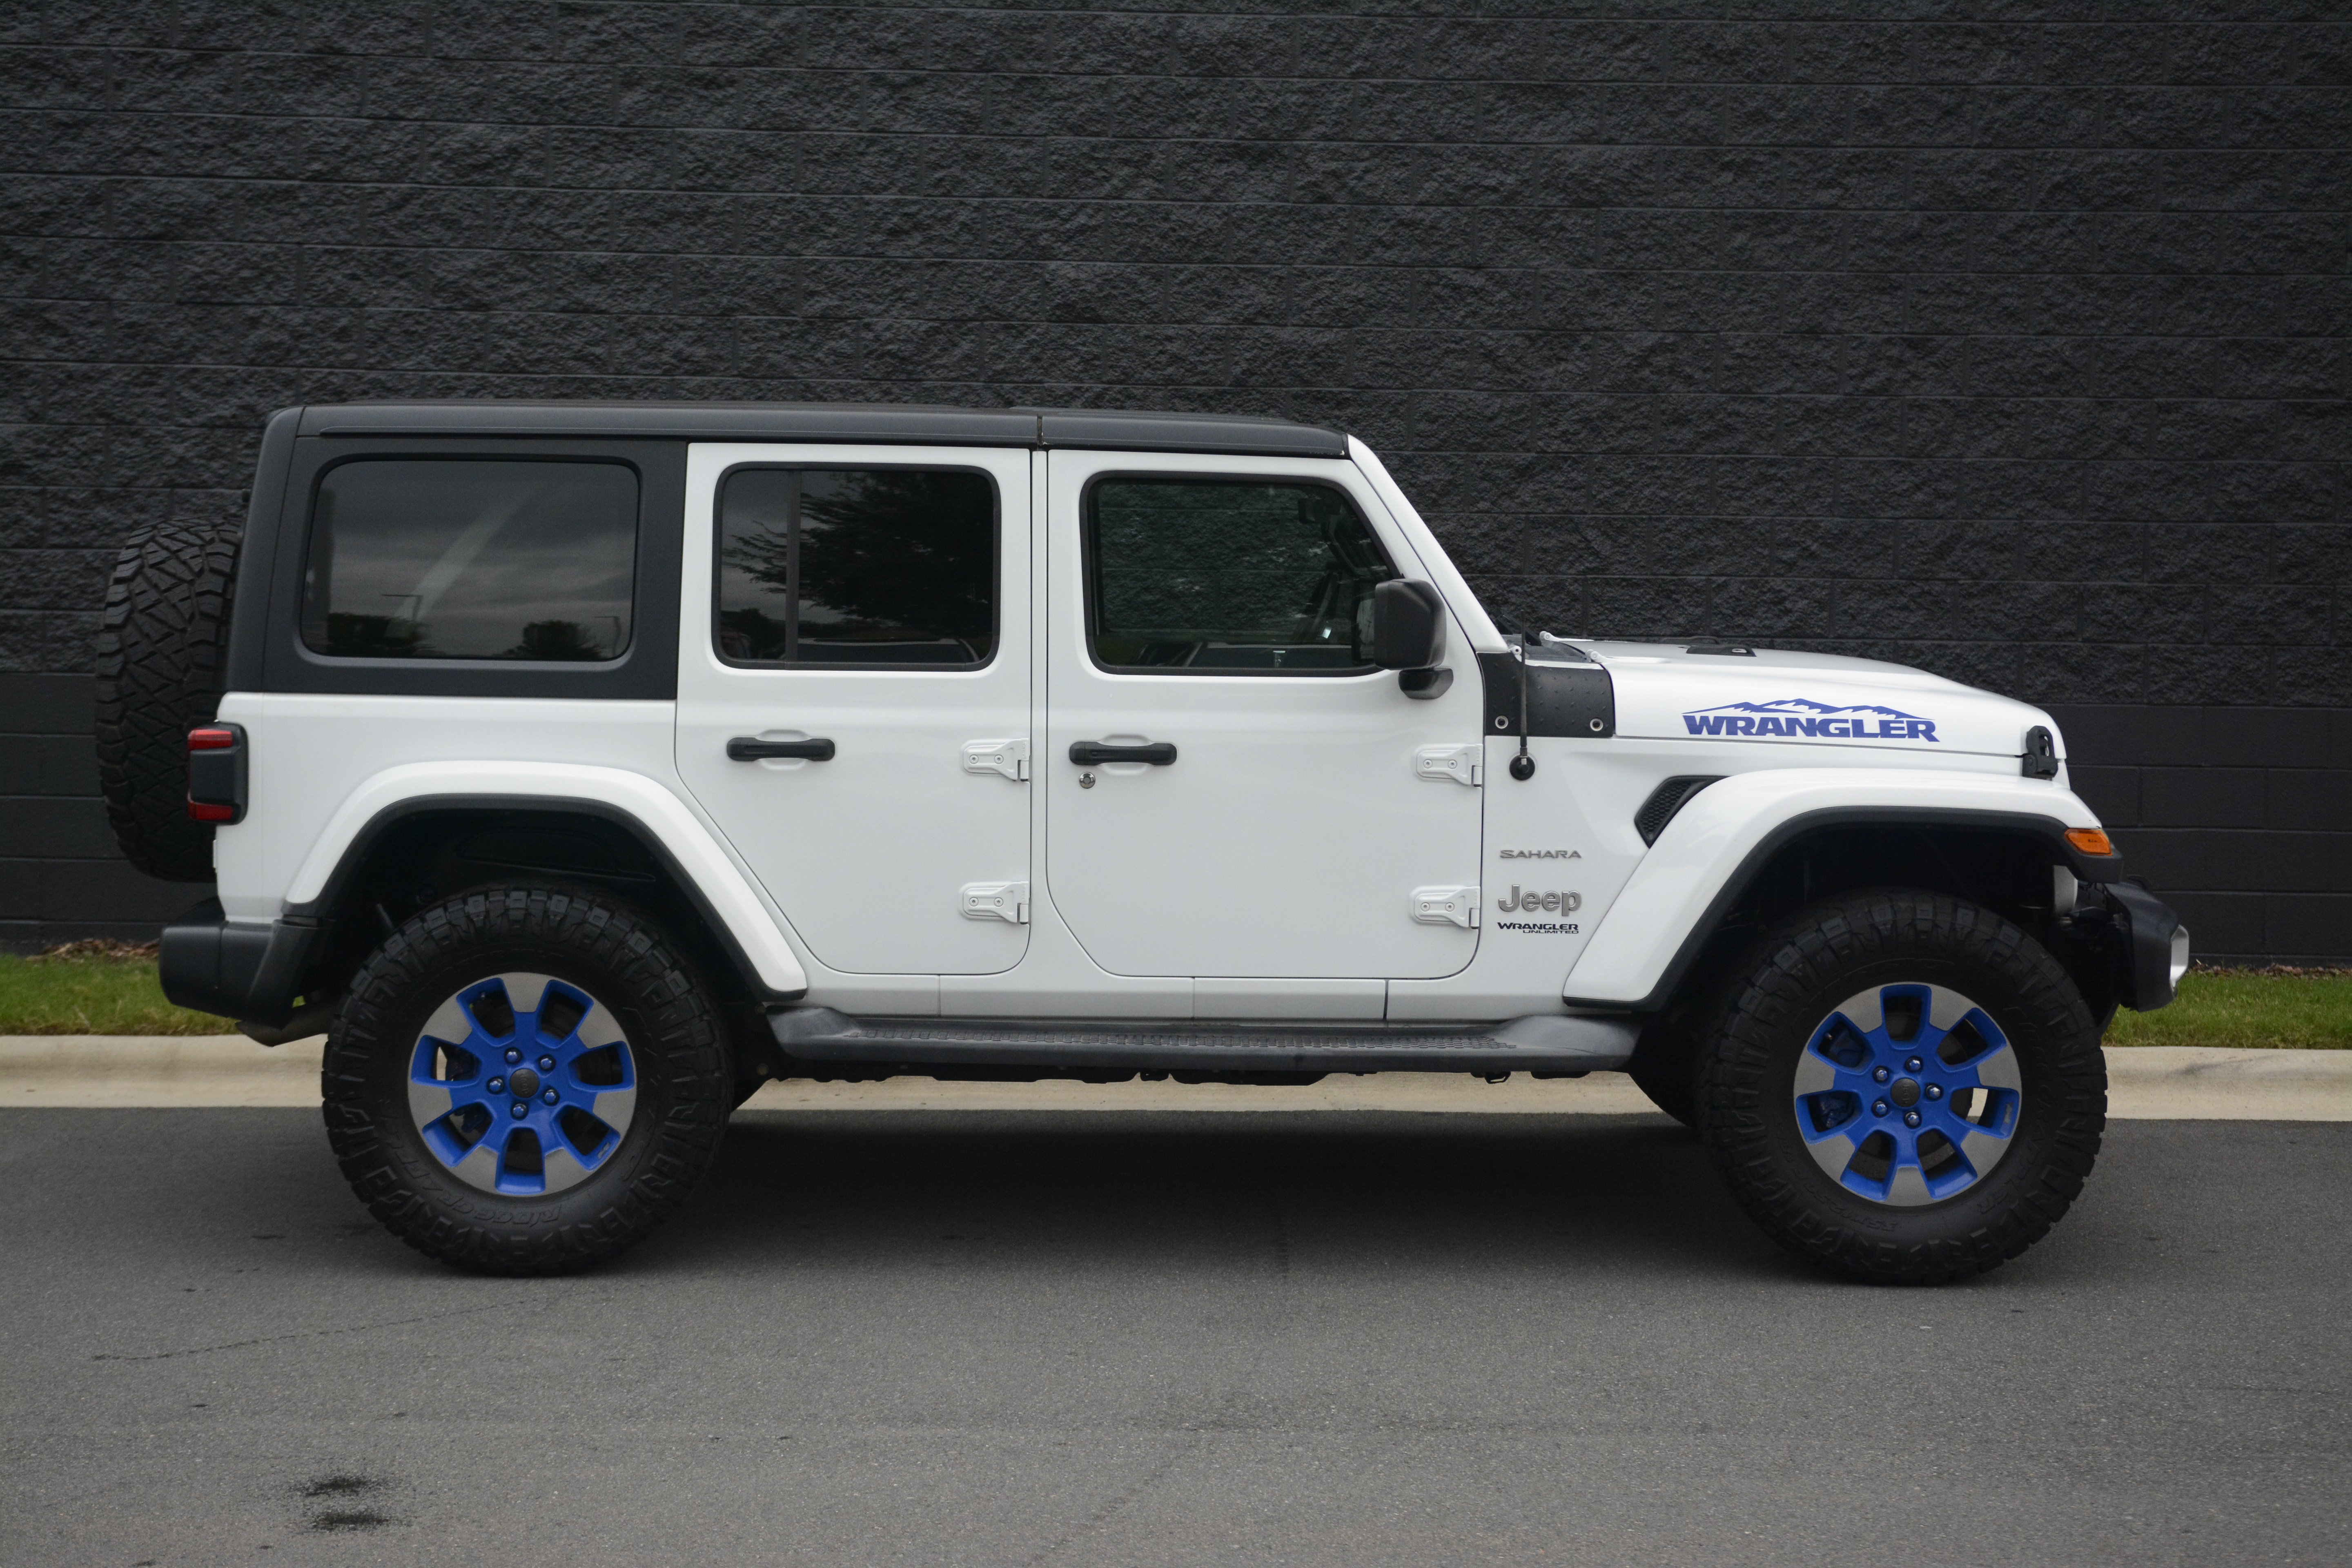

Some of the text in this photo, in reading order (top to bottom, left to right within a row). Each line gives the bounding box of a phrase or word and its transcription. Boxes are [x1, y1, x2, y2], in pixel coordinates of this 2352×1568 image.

[1682, 715, 1940, 742] WRANGLER
[1500, 850, 1581, 858] SAHARA
[1498, 884, 1581, 916] Jeep
[1497, 922, 1579, 930] WRANGLER
[474, 1205, 565, 1226] RIDGE
